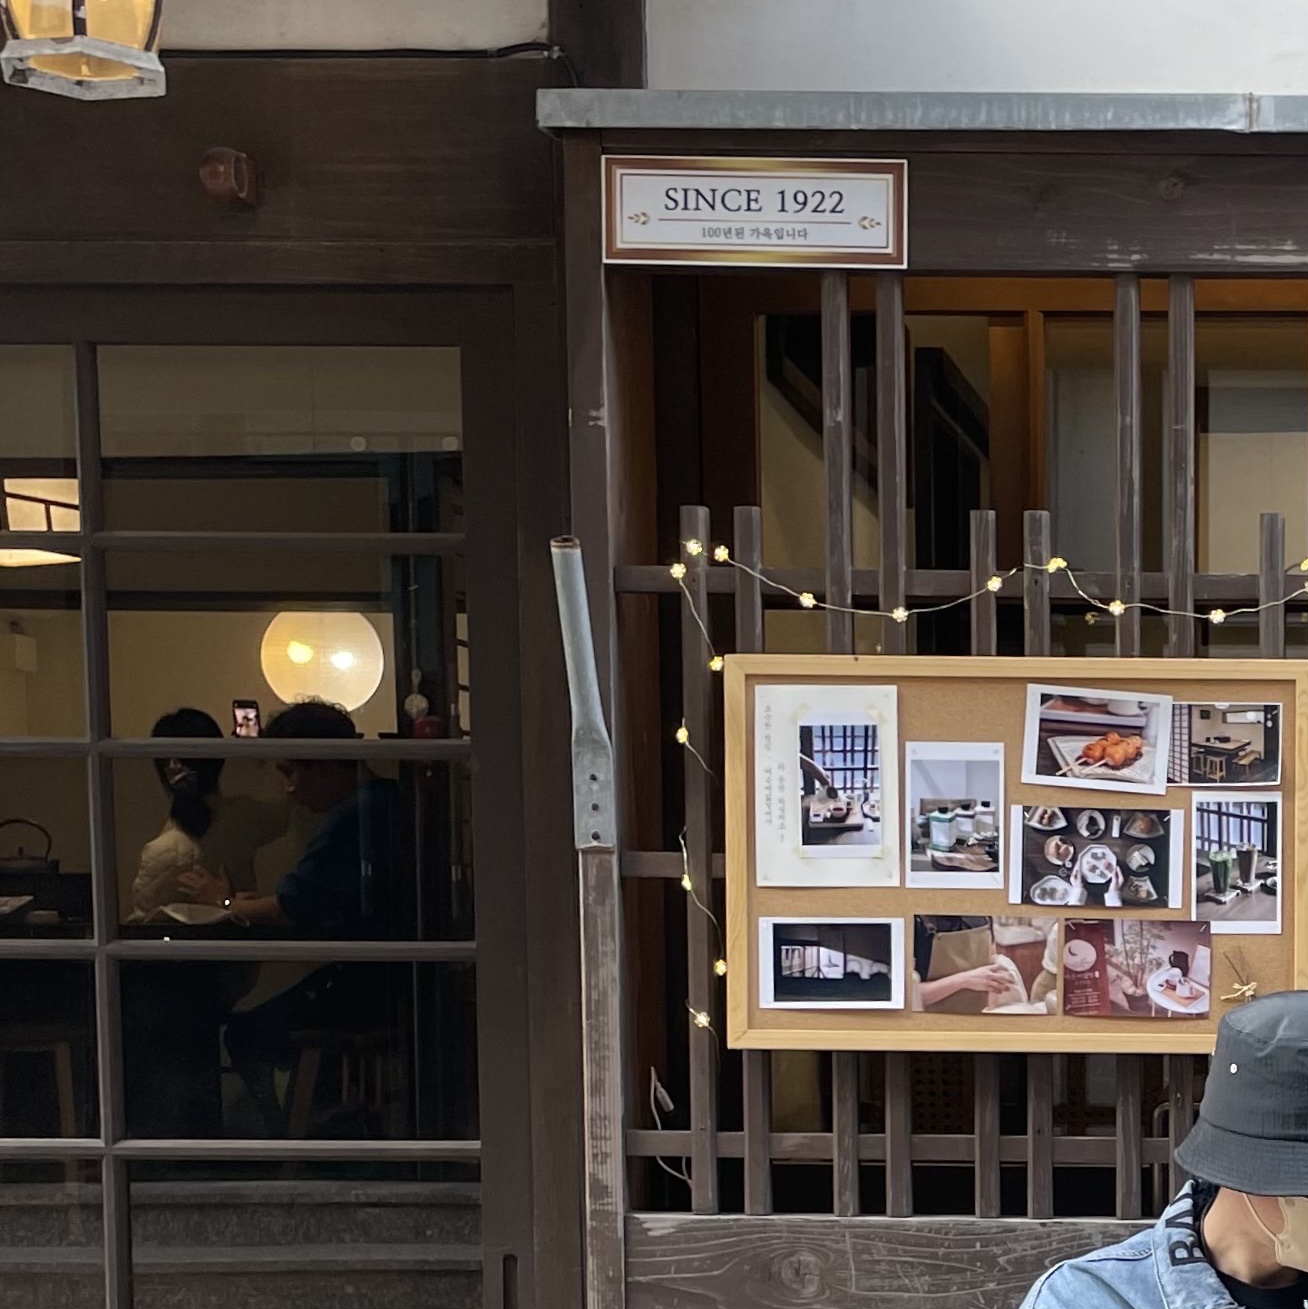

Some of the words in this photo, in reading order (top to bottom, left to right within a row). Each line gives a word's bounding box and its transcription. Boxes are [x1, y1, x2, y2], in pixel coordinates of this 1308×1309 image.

[664, 187, 763, 213] SINCE
[777, 189, 845, 214] 1922
[701, 226, 745, 240] 100년된
